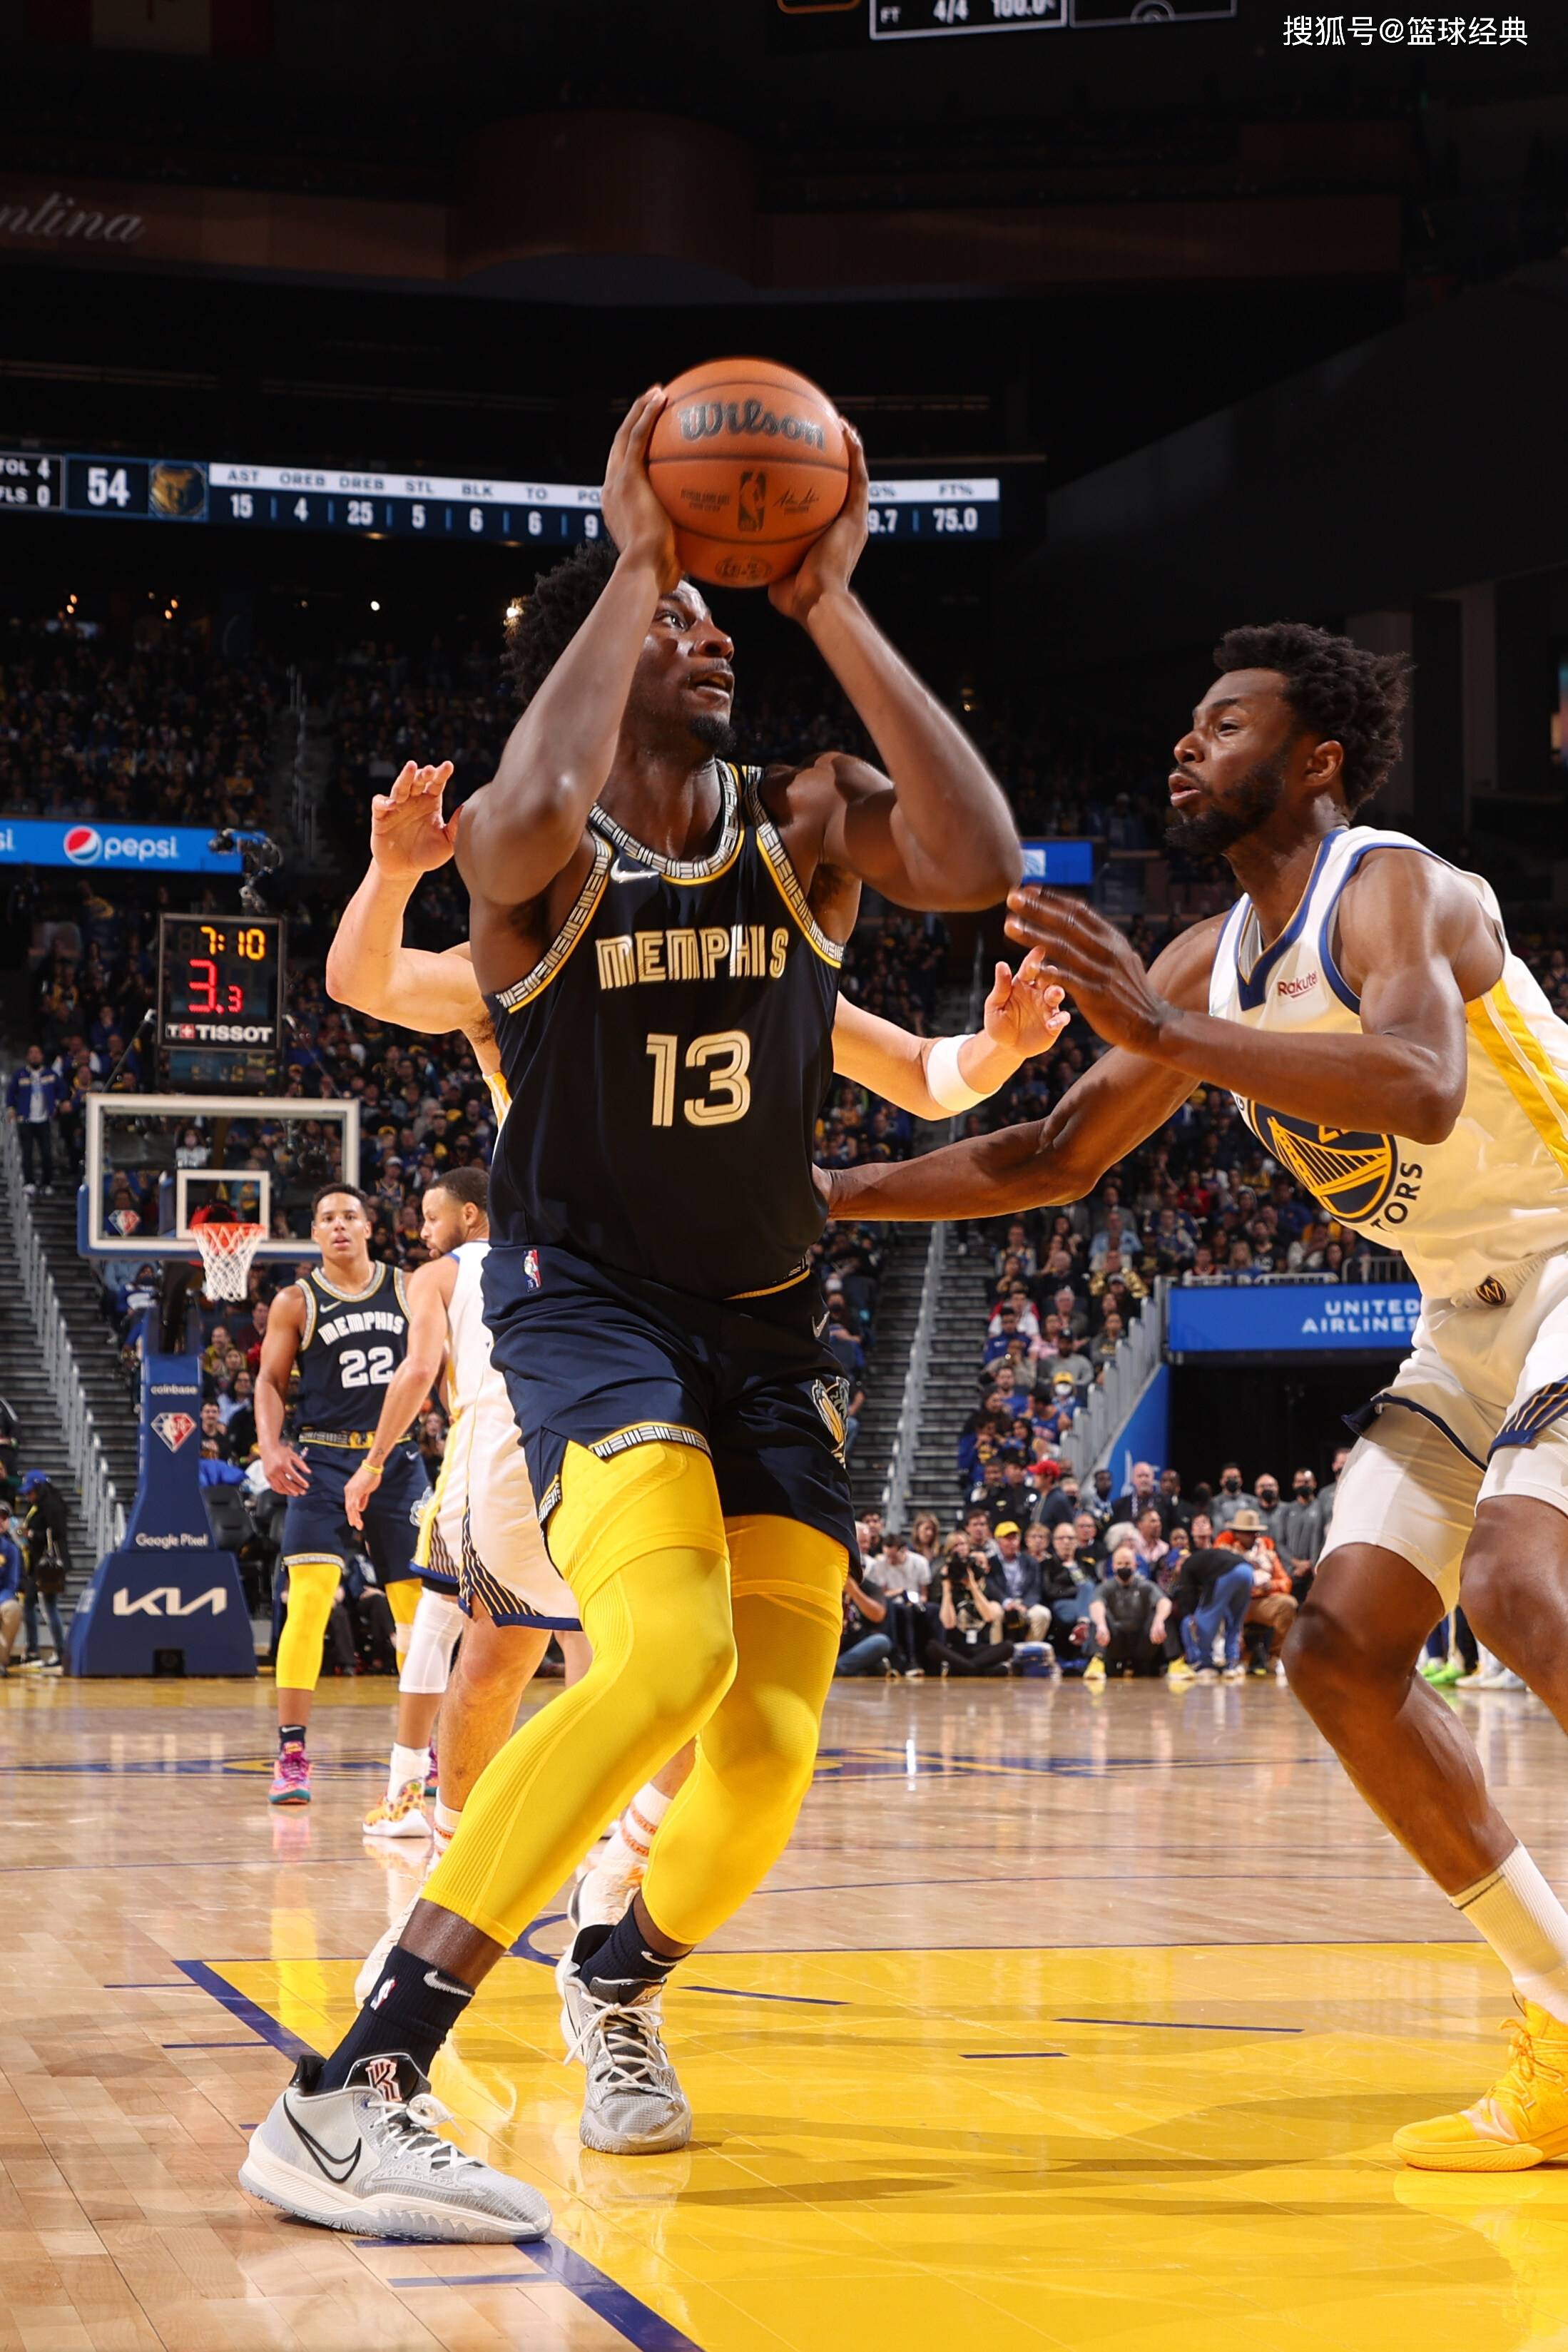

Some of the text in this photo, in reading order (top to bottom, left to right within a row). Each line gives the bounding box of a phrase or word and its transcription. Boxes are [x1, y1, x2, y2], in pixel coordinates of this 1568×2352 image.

[677, 399, 826, 450] Wilson
[37, 457, 51, 480] 4
[37, 484, 51, 508] 0
[88, 467, 131, 507] 54
[228, 469, 260, 482] AST
[280, 471, 326, 486] OREB
[339, 476, 385, 489] DREB
[405, 479, 434, 494] STL
[462, 483, 493, 497] BLK
[526, 487, 547, 500] TO
[939, 484, 973, 495] FT%
[230, 493, 253, 519] 15
[294, 497, 308, 522] 4
[347, 500, 374, 526] 25
[412, 504, 426, 529] 5
[469, 507, 484, 532] 6
[528, 510, 542, 536] 6
[867, 508, 898, 533] 9.7
[932, 506, 978, 533] 75.0
[104, 835, 180, 862] pepsi
[201, 926, 265, 960] 7:10
[595, 924, 789, 991] MEMPHIS
[1277, 970, 1318, 997] Rakute
[195, 1024, 274, 1043] TISSOT
[646, 1030, 752, 1127] 13
[1324, 1298, 1420, 1316] UNITED
[317, 1310, 405, 1346] MEMPHIS
[339, 1346, 395, 1389] 22
[150, 1383, 198, 1395] coinbase
[136, 1533, 208, 1550] Google Pixel
